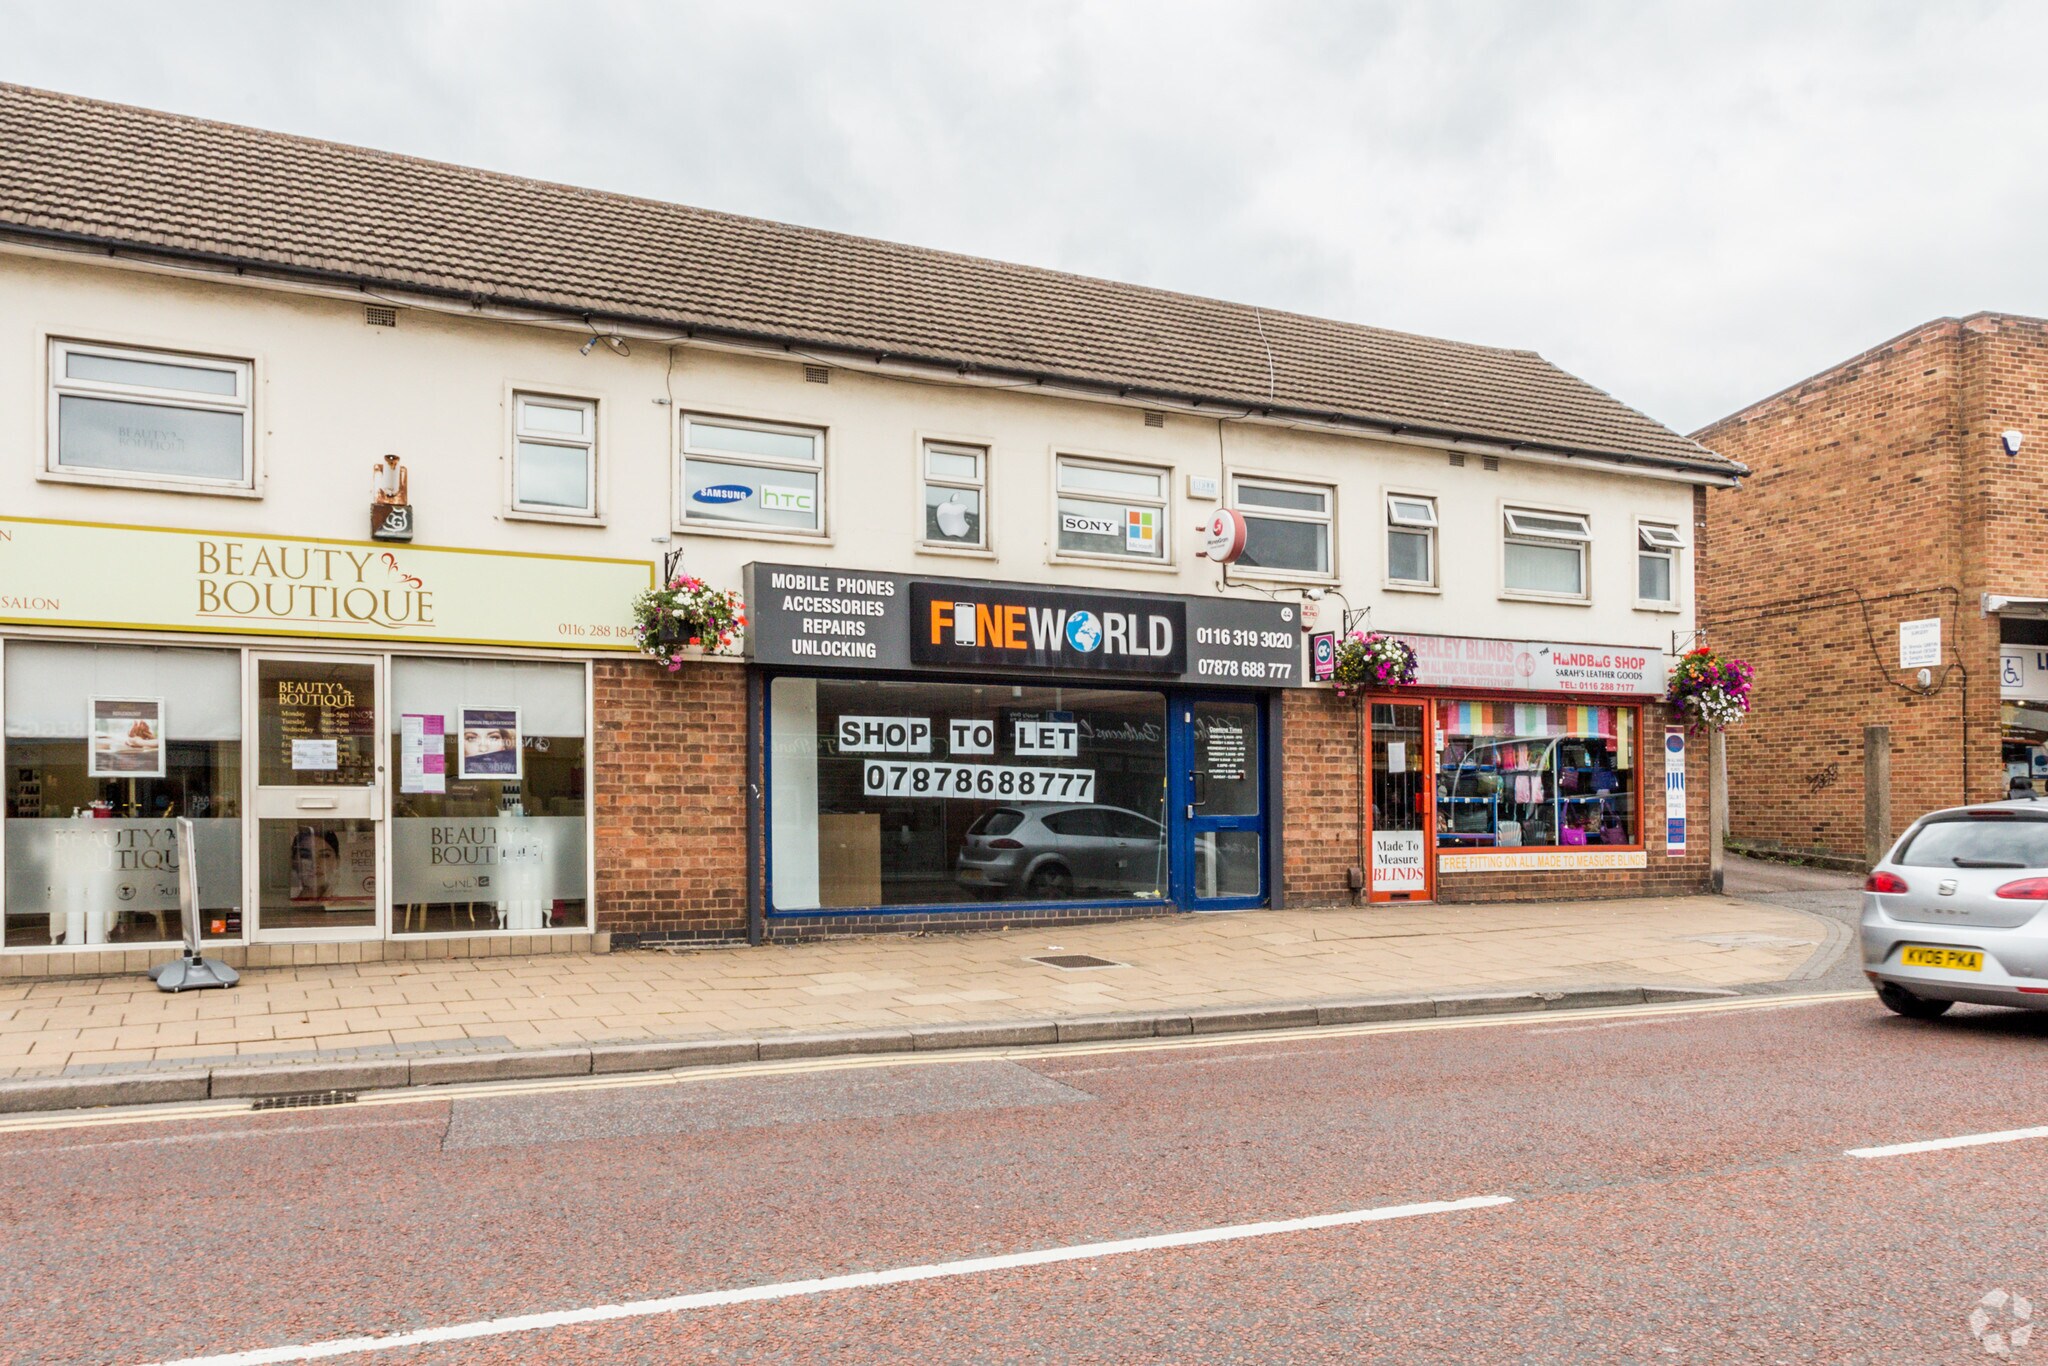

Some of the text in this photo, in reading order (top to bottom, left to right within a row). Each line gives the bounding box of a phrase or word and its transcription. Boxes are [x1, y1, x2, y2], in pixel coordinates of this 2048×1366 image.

[700, 487, 746, 500] SAMSUNG
[1066, 518, 1113, 532] SONY
[197, 541, 375, 583] BEAUTY
[771, 573, 895, 596] MOBILE PHONES
[1, 596, 60, 610] SALON
[198, 579, 434, 629] BOUTIQUE
[783, 596, 885, 616] ACCESSORIES
[558, 623, 586, 636] 0116
[589, 624, 611, 637] 288
[803, 618, 865, 637] REPAIRS
[1197, 627, 1292, 649] 0116 319 3020
[792, 639, 876, 659] UNLOCKING
[1465, 638, 1515, 662] BLINDS
[1539, 648, 1550, 656] THE
[1198, 658, 1292, 679] 07878 688 777
[1615, 656, 1646, 670] SHOP
[1556, 669, 1643, 680] SARAH'S LEATHER GOODS
[1560, 681, 1577, 689] TEL:
[1616, 683, 1634, 691] 7177
[279, 694, 355, 709] BOUTIQUE
[841, 721, 928, 747] SHOP
[952, 724, 991, 749] TO
[1019, 729, 1076, 751] LET
[867, 764, 1092, 798] 07878688777
[1377, 840, 1419, 851] Made To
[1378, 854, 1419, 865] Measure
[1444, 854, 1645, 870] FREE FITTING ON ALL MADE TO MEASURE BLINDS
[1374, 867, 1424, 881] BLINDS
